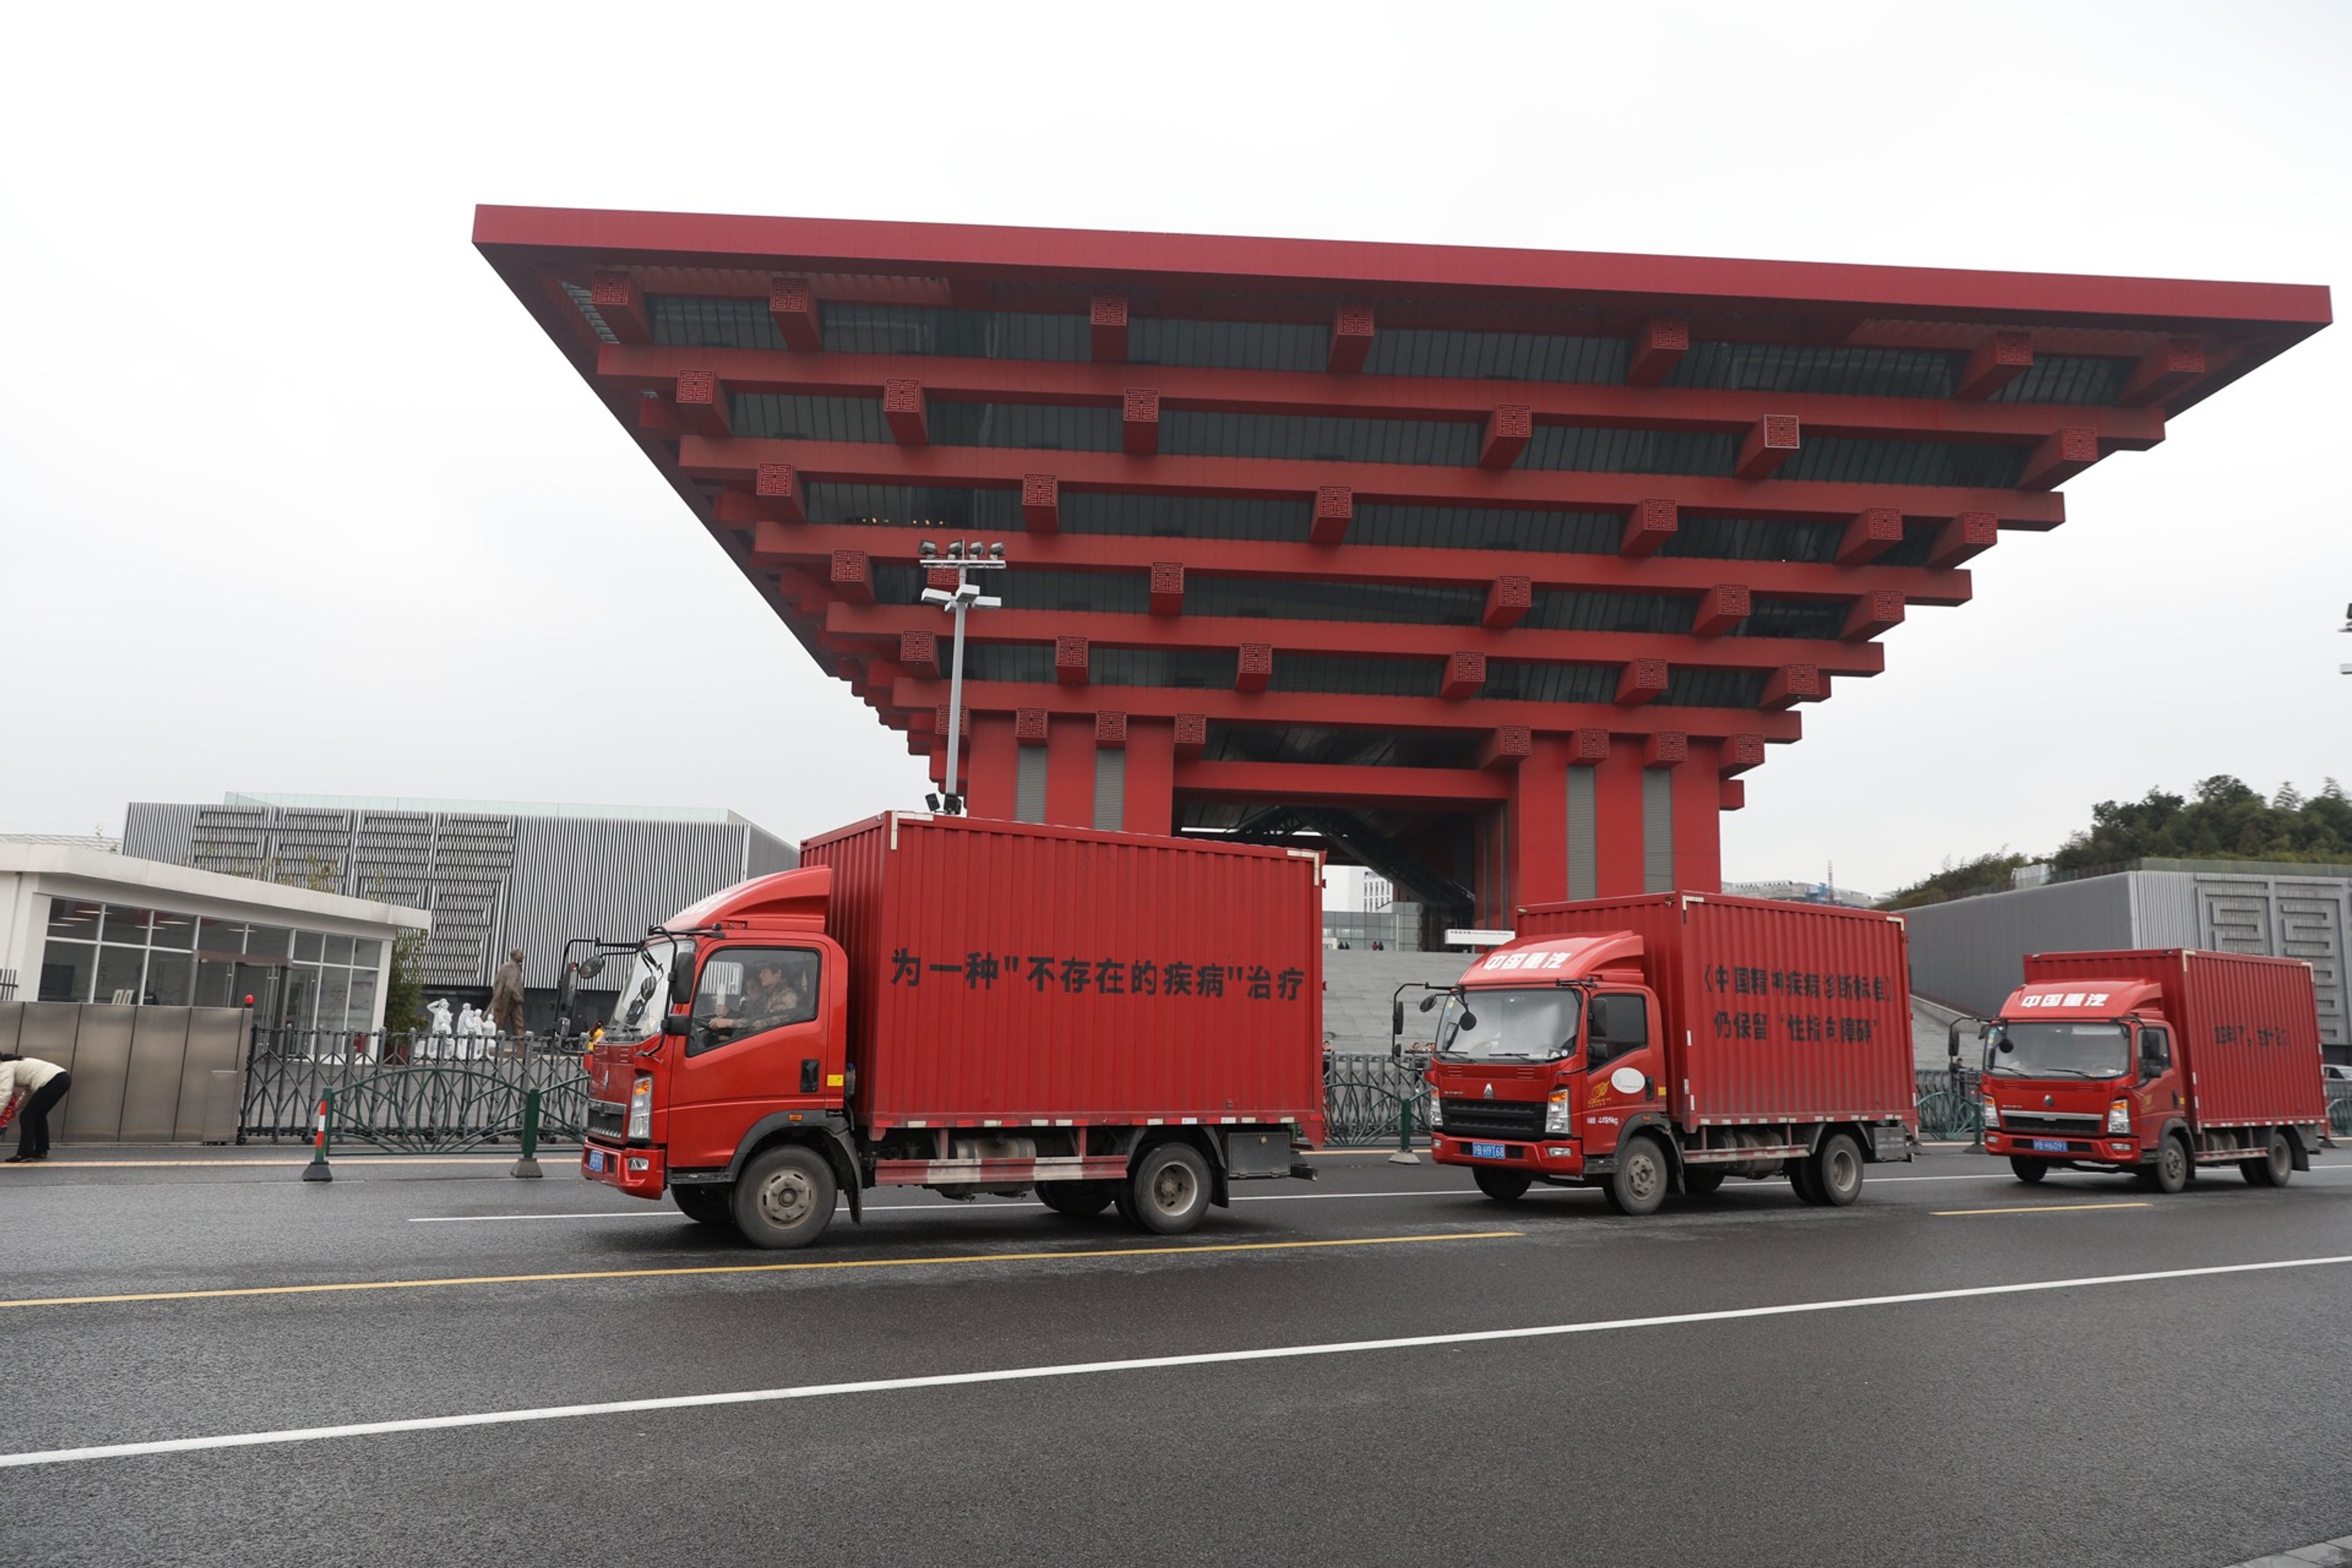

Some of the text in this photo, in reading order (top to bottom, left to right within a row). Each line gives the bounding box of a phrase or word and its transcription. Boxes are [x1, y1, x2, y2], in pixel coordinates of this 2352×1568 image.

[1482, 951, 1572, 971] 中国重汽
[891, 948, 1305, 1001] 为一种"不存在的疾病"治疗
[2021, 993, 2110, 1008] 中国重汽
